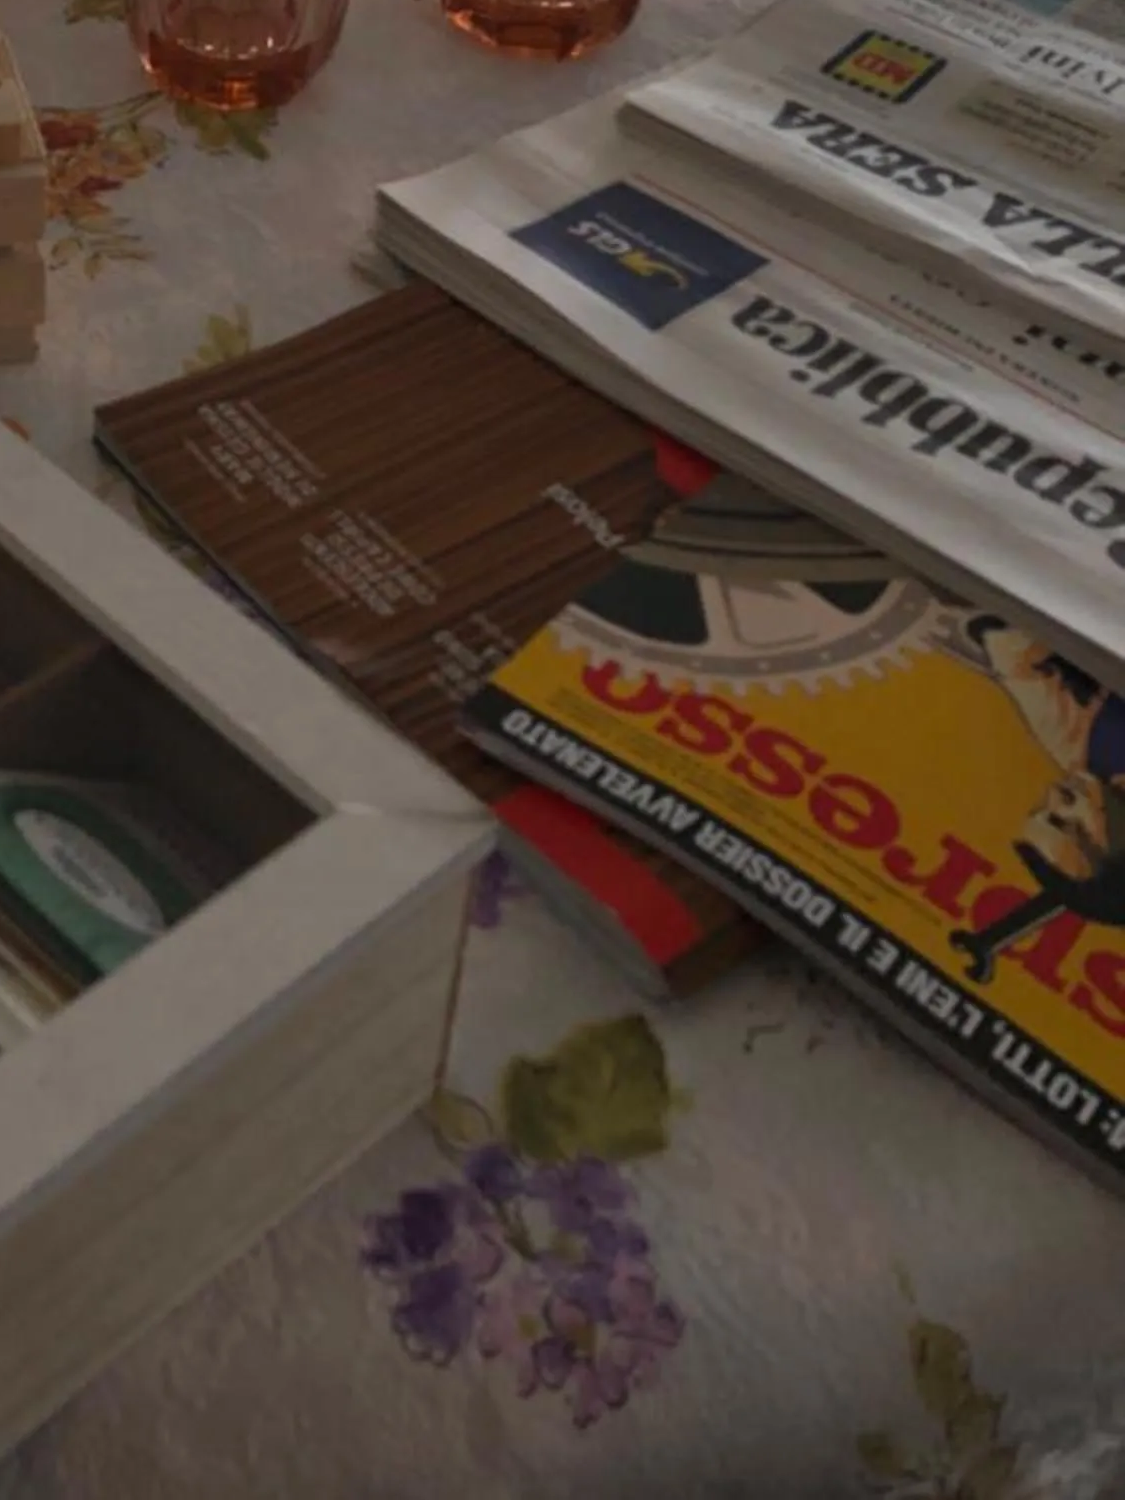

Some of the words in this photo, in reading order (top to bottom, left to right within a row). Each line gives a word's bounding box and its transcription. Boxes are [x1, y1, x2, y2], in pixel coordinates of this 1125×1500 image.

[773, 100, 978, 197] SERA
[982, 191, 1125, 288] LLA
[499, 707, 701, 832] AVVELENATO
[693, 819, 837, 929] DOSSIER
[836, 912, 872, 952] IL
[866, 936, 899, 975] E
[895, 959, 984, 1038] L'ENI
[991, 1019, 1101, 1126] LOTTI,
